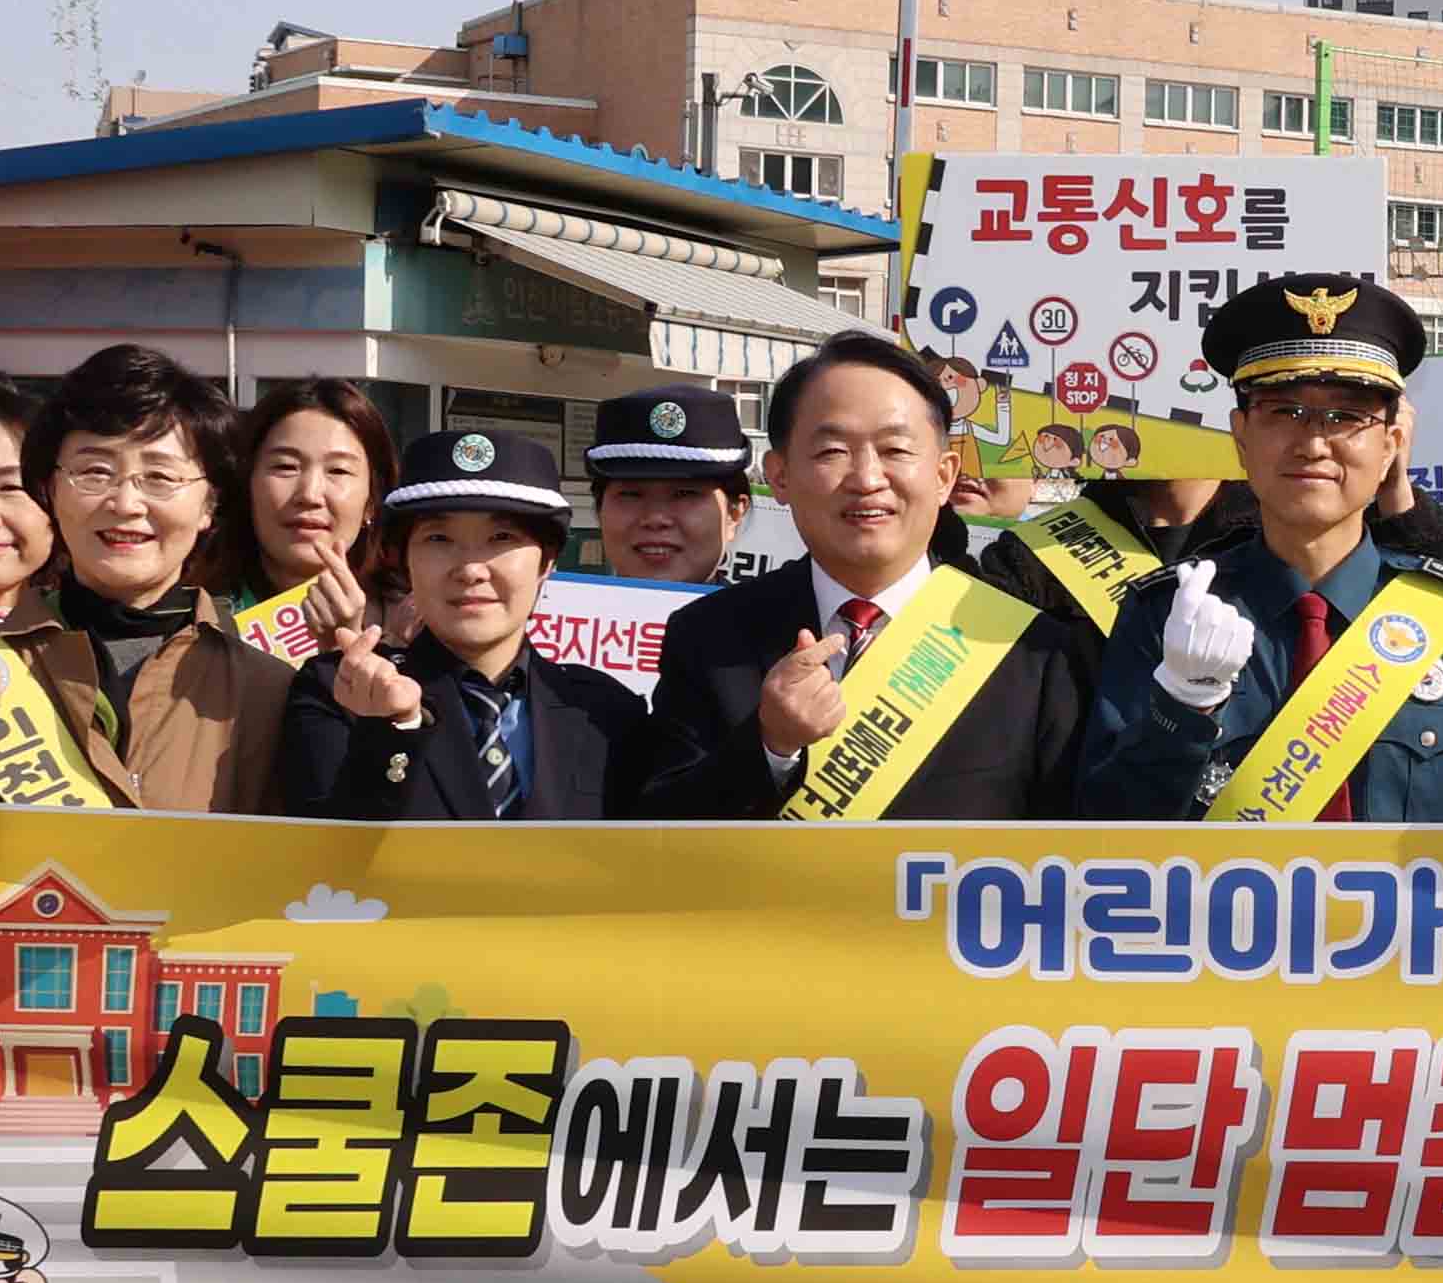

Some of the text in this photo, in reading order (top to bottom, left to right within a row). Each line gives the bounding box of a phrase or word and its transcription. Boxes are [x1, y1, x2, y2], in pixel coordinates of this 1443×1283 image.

[971, 172, 1290, 255] 교통신호를
[1041, 309, 1066, 329] 30
[1066, 391, 1098, 405] STOP
[1305, 663, 1381, 750] 스쿨존
[802, 694, 913, 818] 교통법규
[1260, 739, 1322, 812] 안전
[96, 1023, 912, 1245] 스쿨존에서는
[957, 1043, 1248, 1243] 일단
